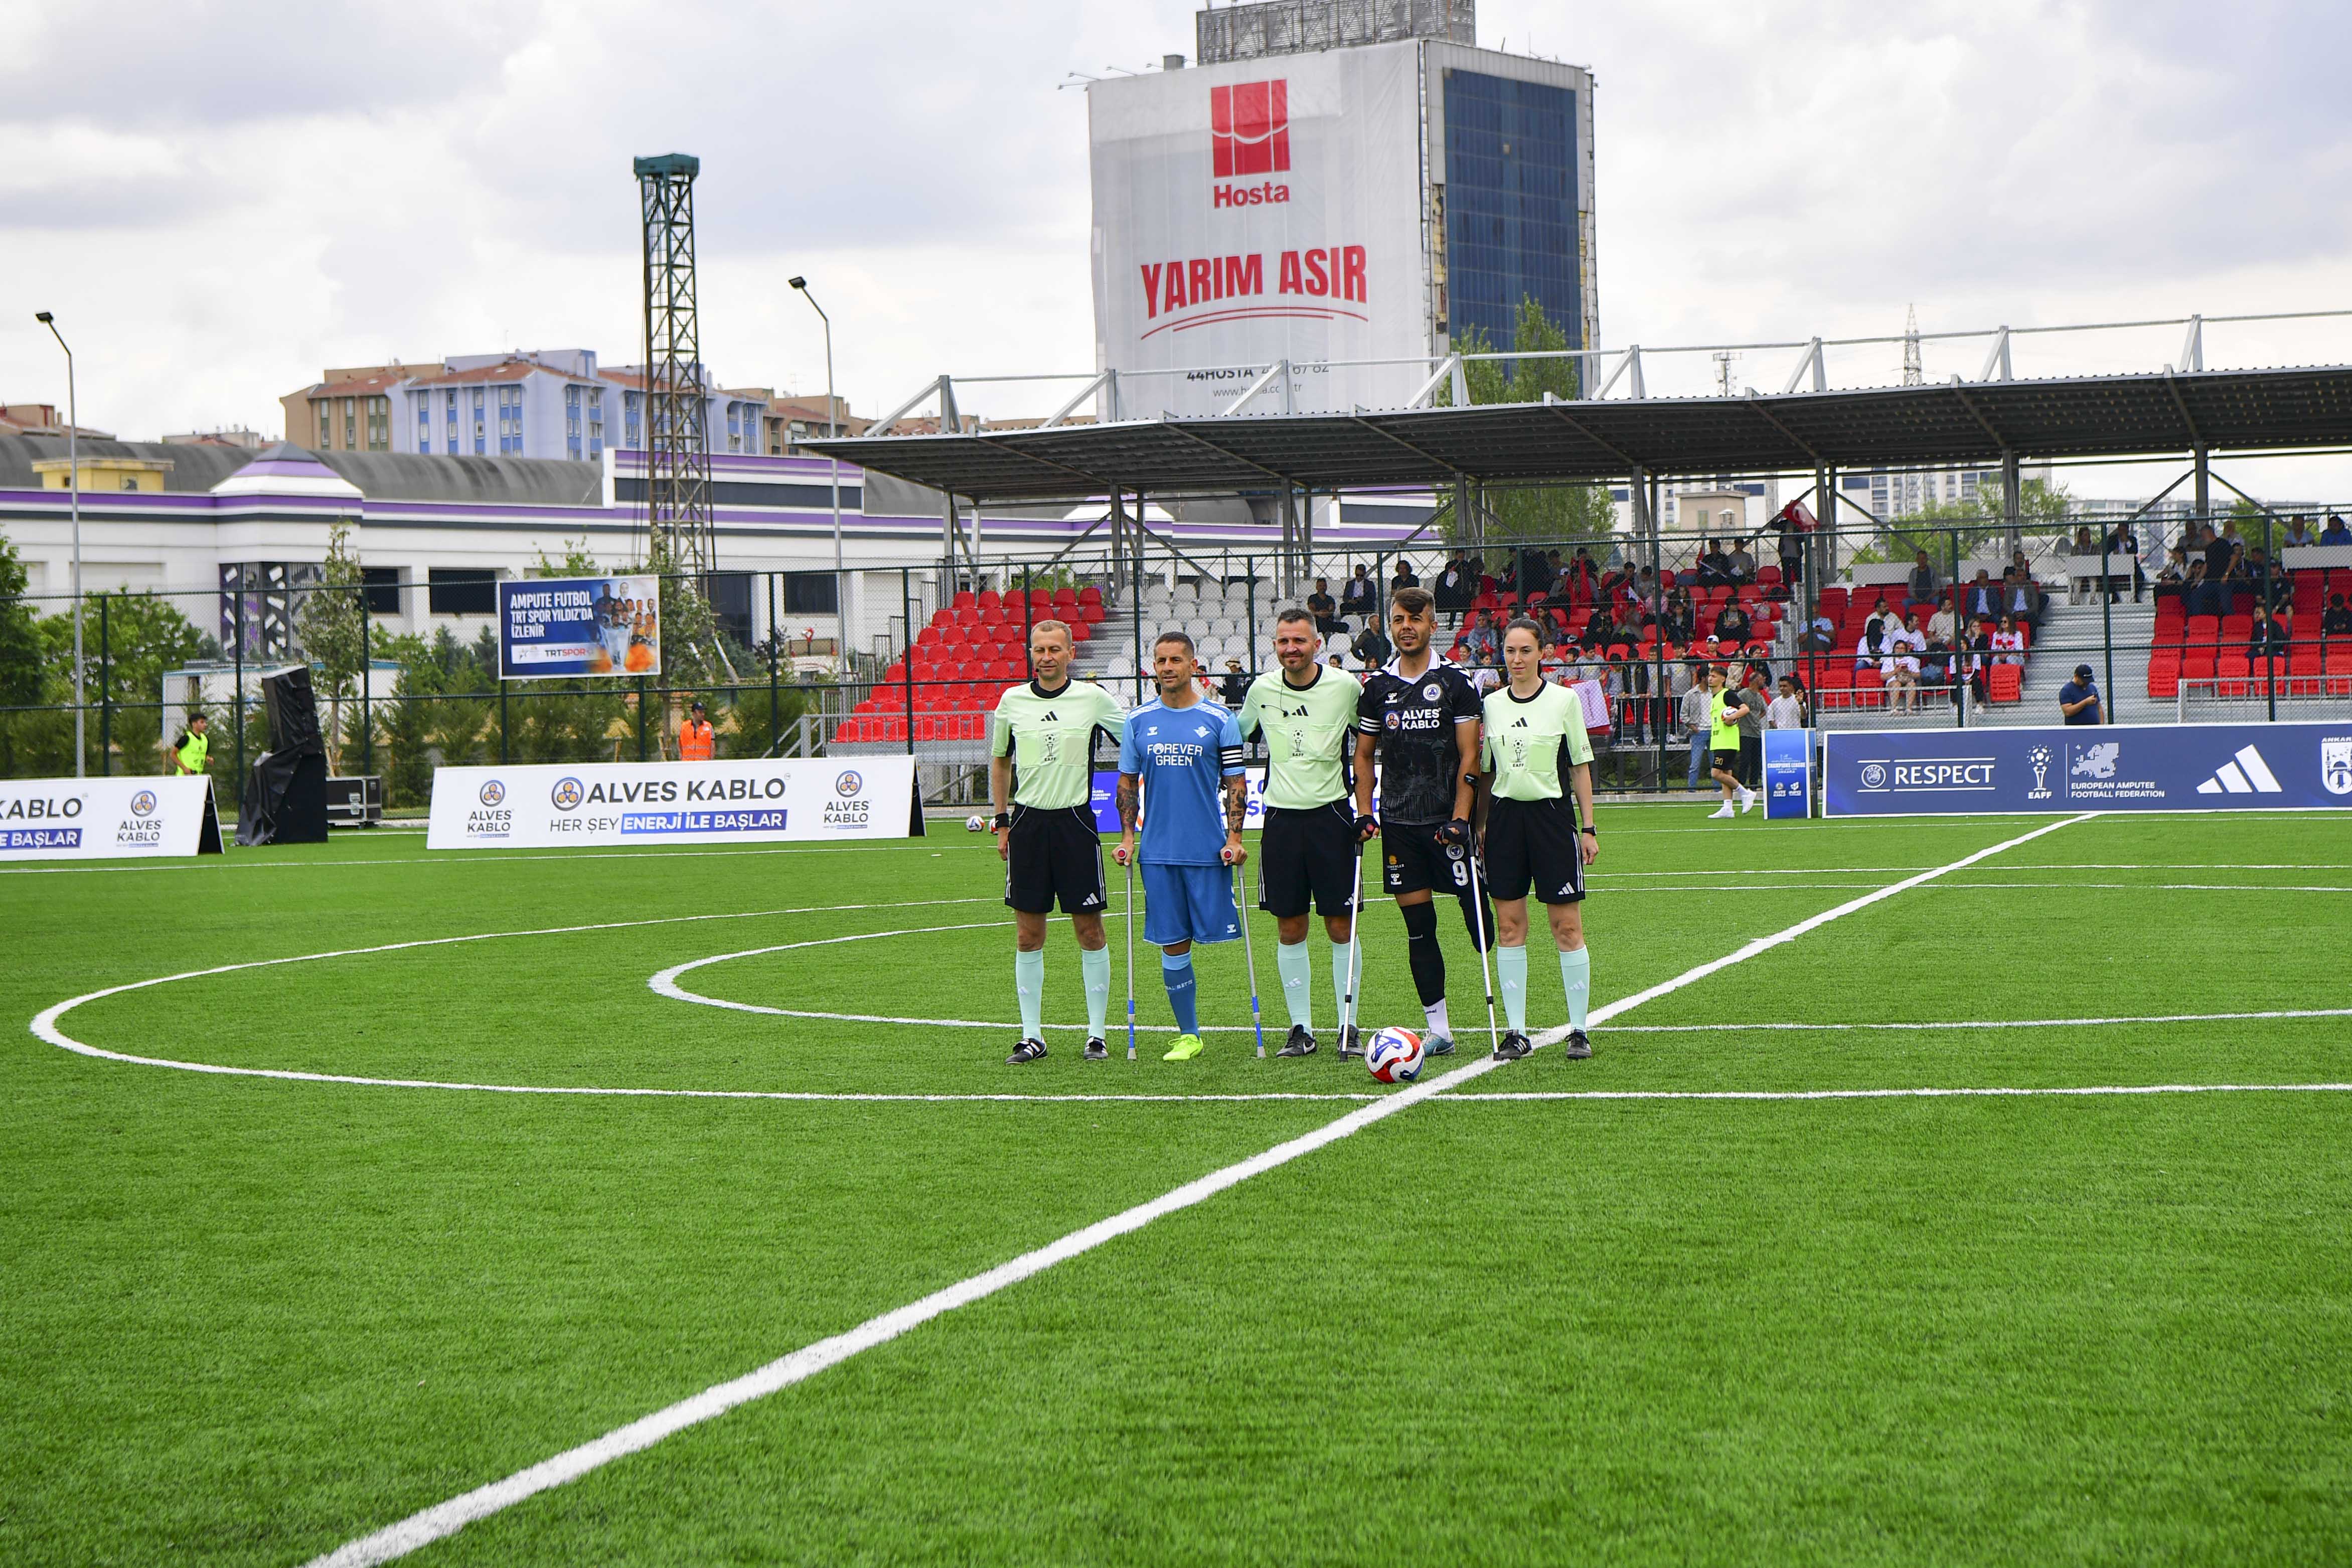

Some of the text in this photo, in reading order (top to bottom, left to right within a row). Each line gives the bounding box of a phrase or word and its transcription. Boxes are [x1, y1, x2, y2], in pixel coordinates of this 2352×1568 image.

[1213, 181, 1290, 209] Hosta
[1141, 245, 1367, 320] YARIM ASIR
[510, 590, 593, 609] AMPUTE FUTBOL
[511, 607, 594, 623] TRT SPOR YILDIZ'DA
[511, 622, 545, 638] İZLENİR
[1401, 708, 1440, 720] ALVES
[1401, 719, 1440, 730] KABLO
[1155, 755, 1193, 766] GREEN
[1895, 764, 1995, 785] RESPECT
[586, 778, 786, 804] ALVES KABLO
[2028, 791, 2053, 799] EAFF
[2115, 790, 2165, 798] FEDERATION
[825, 801, 869, 812] ALVES
[469, 810, 512, 821] ALVES
[824, 813, 868, 823] KABLO
[119, 819, 162, 831] ALVES
[467, 822, 511, 832] KABLO
[550, 812, 782, 834] HER ŞEY ENERJİ İLE BAŞLAR
[11, 831, 78, 849] BAŞLAR
[117, 832, 160, 842] KABLO
[1452, 860, 1469, 886] 9
